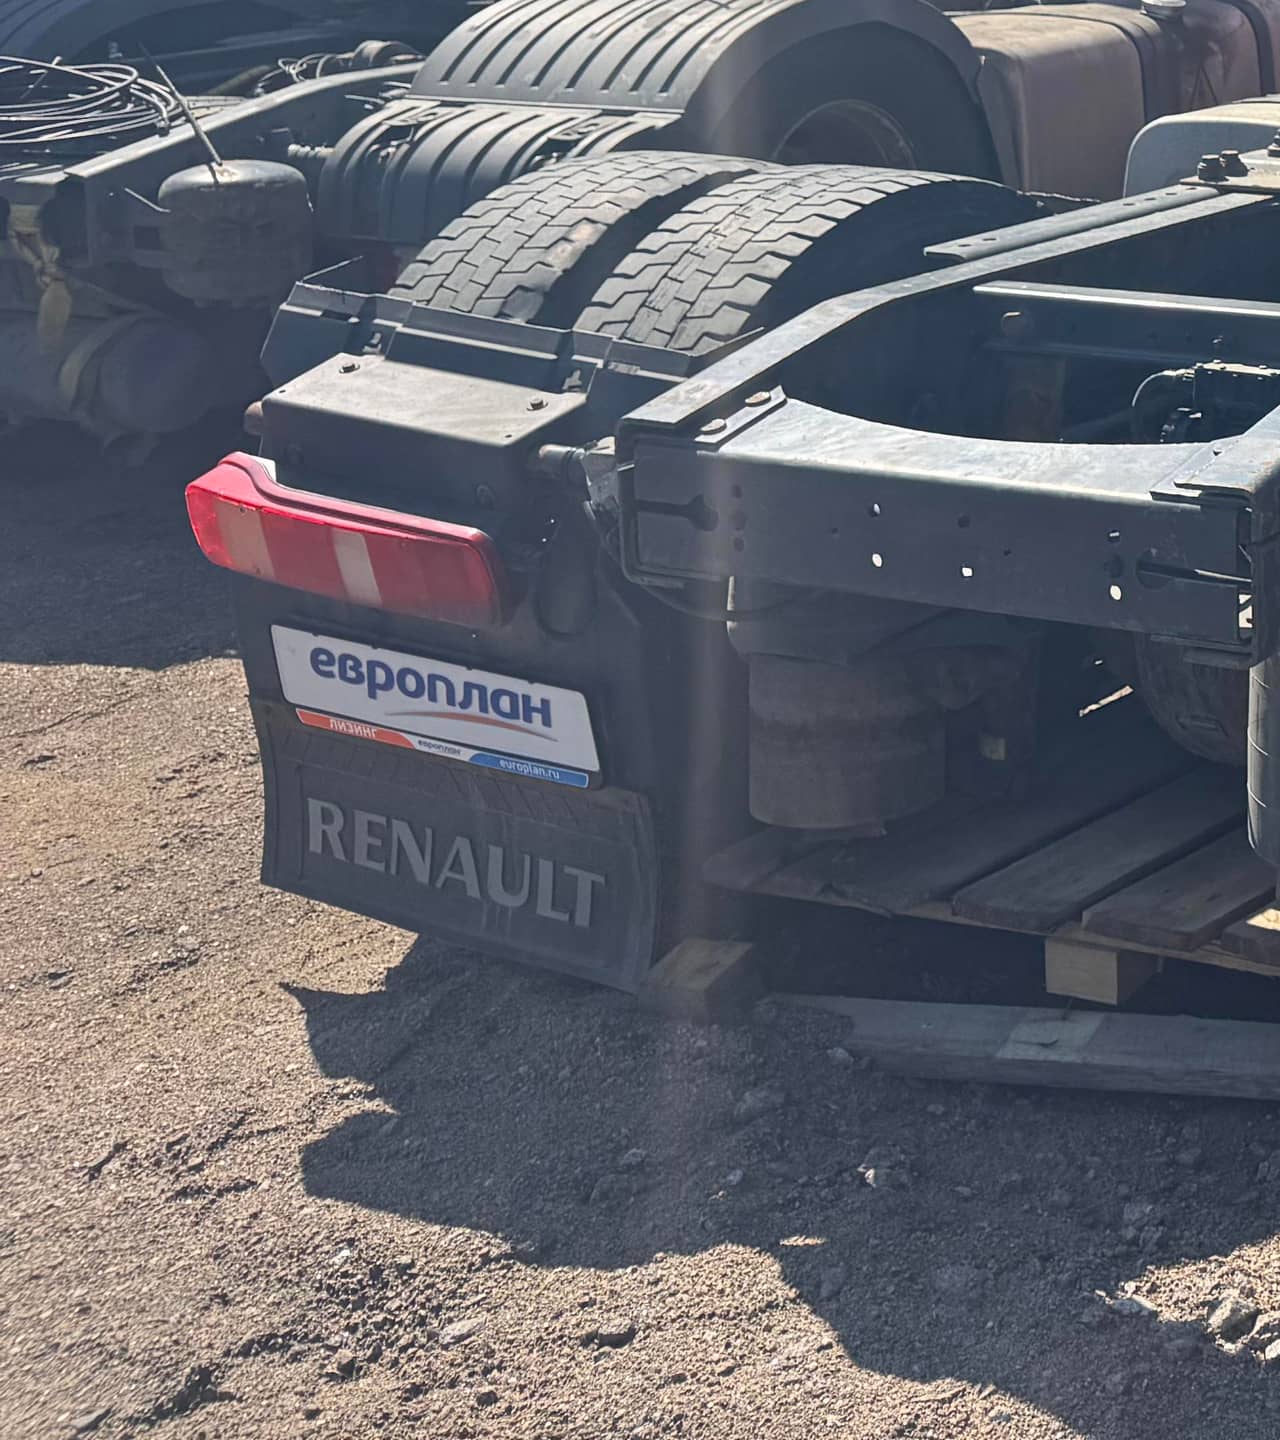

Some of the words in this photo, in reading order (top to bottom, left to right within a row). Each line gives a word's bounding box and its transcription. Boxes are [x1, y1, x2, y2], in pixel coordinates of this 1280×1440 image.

[310, 647, 553, 728] европлан
[499, 759, 561, 781] europlan.ru
[307, 797, 606, 928] RENAULT
